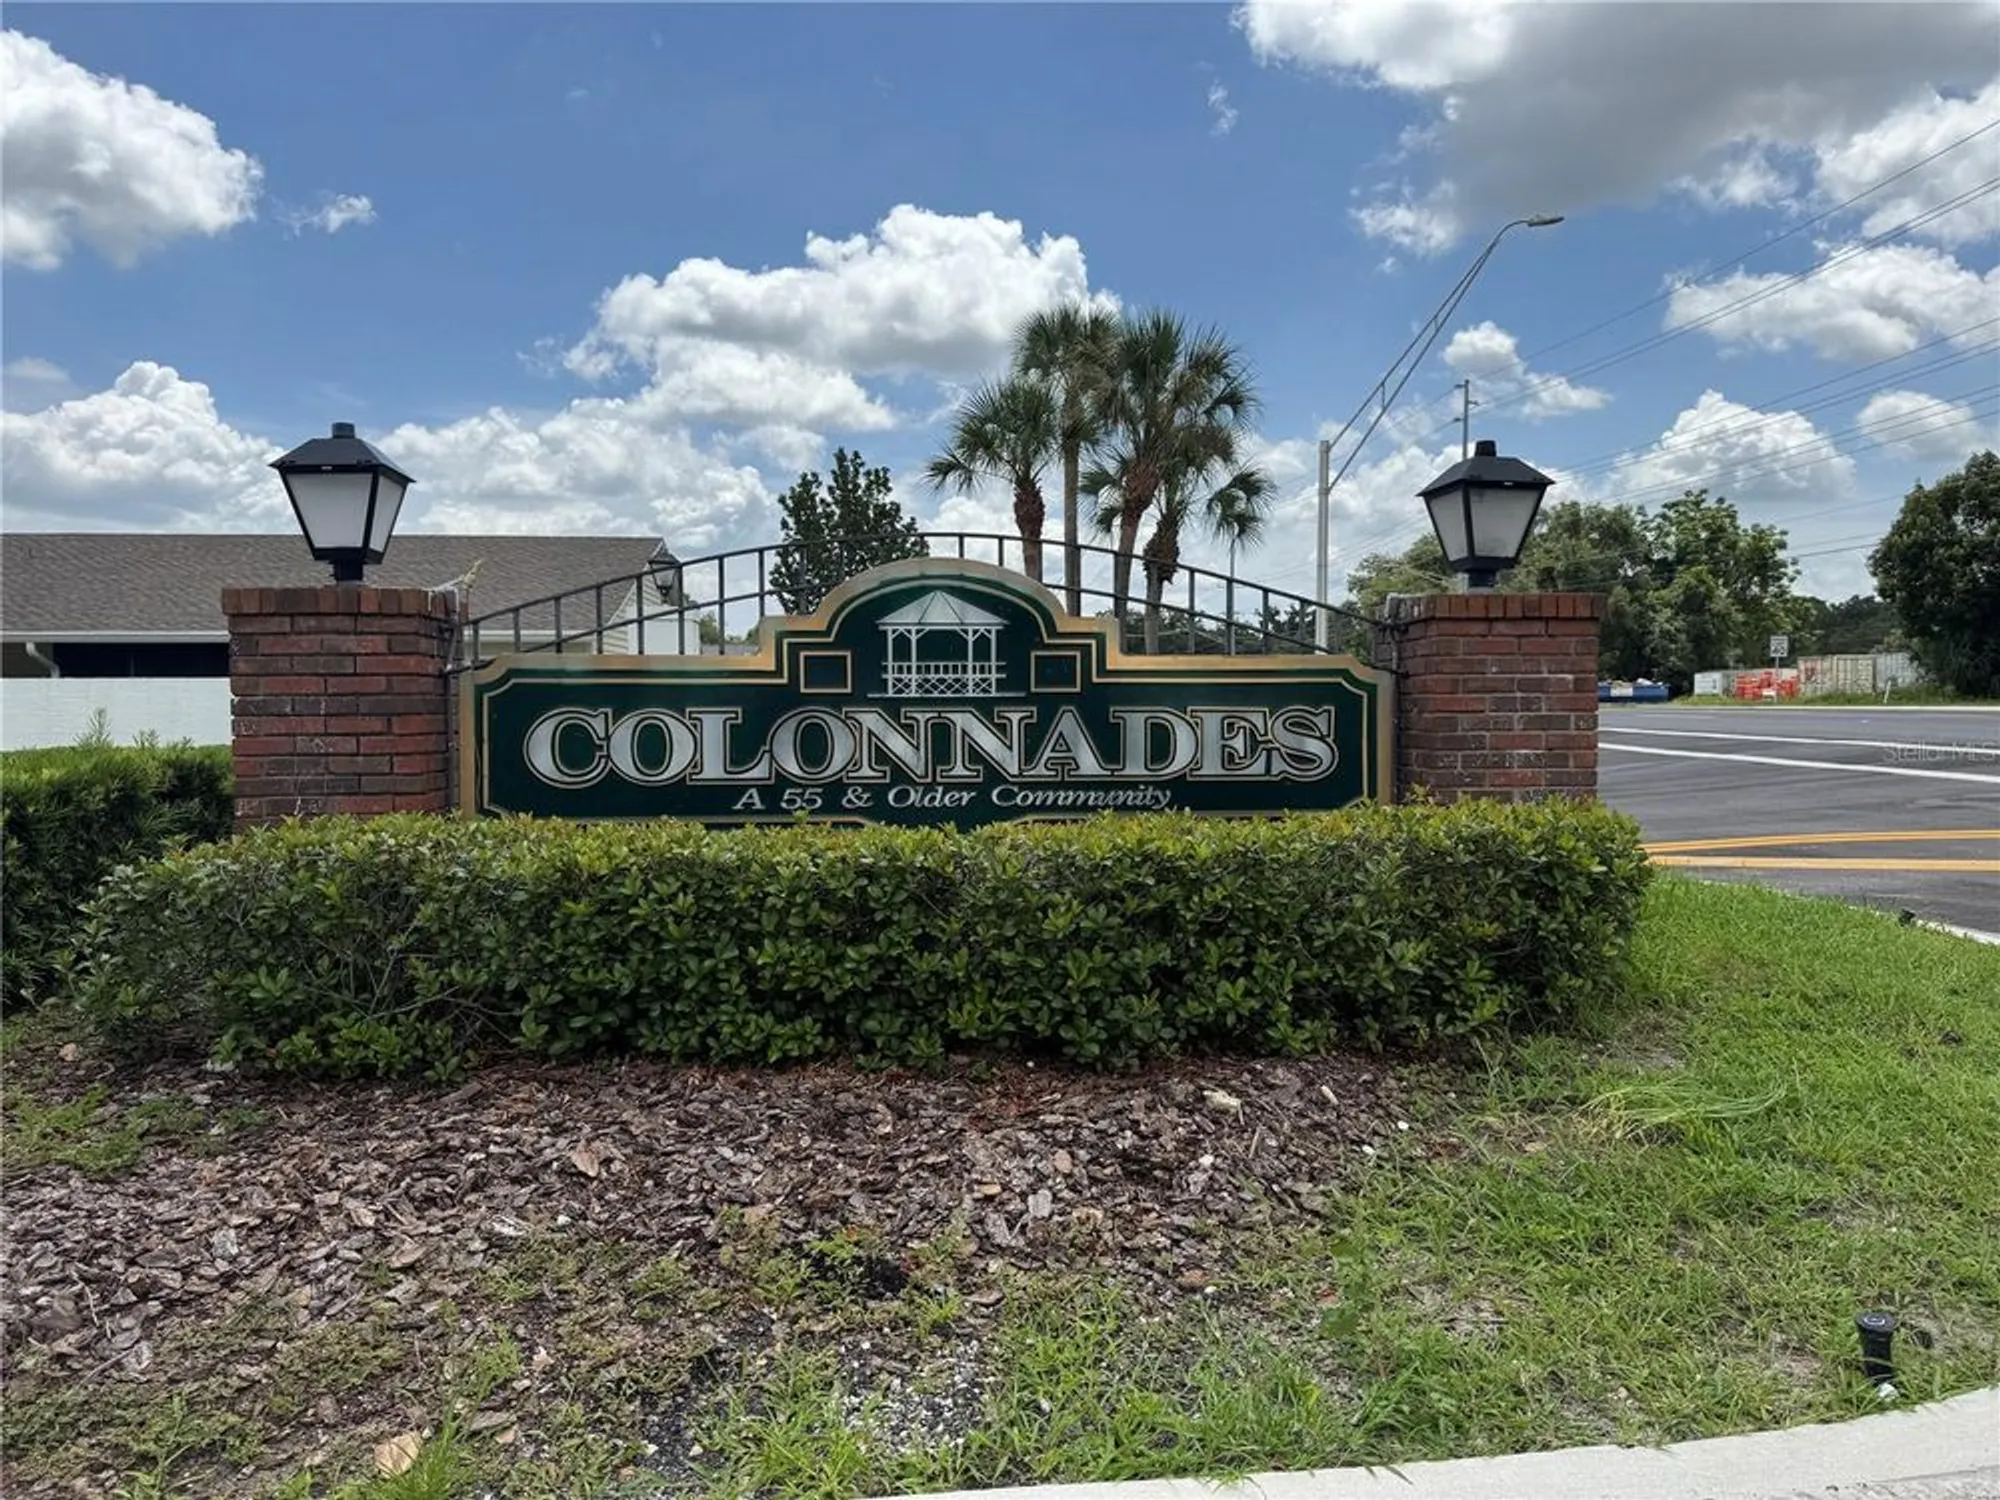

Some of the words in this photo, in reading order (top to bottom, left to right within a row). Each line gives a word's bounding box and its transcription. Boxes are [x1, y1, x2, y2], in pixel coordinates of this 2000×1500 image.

[523, 705, 1339, 787] COLONNADES
[732, 787, 766, 810] A
[780, 787, 824, 810] 55
[842, 785, 874, 808] &
[887, 784, 977, 808] Older
[991, 784, 1172, 810] Community
